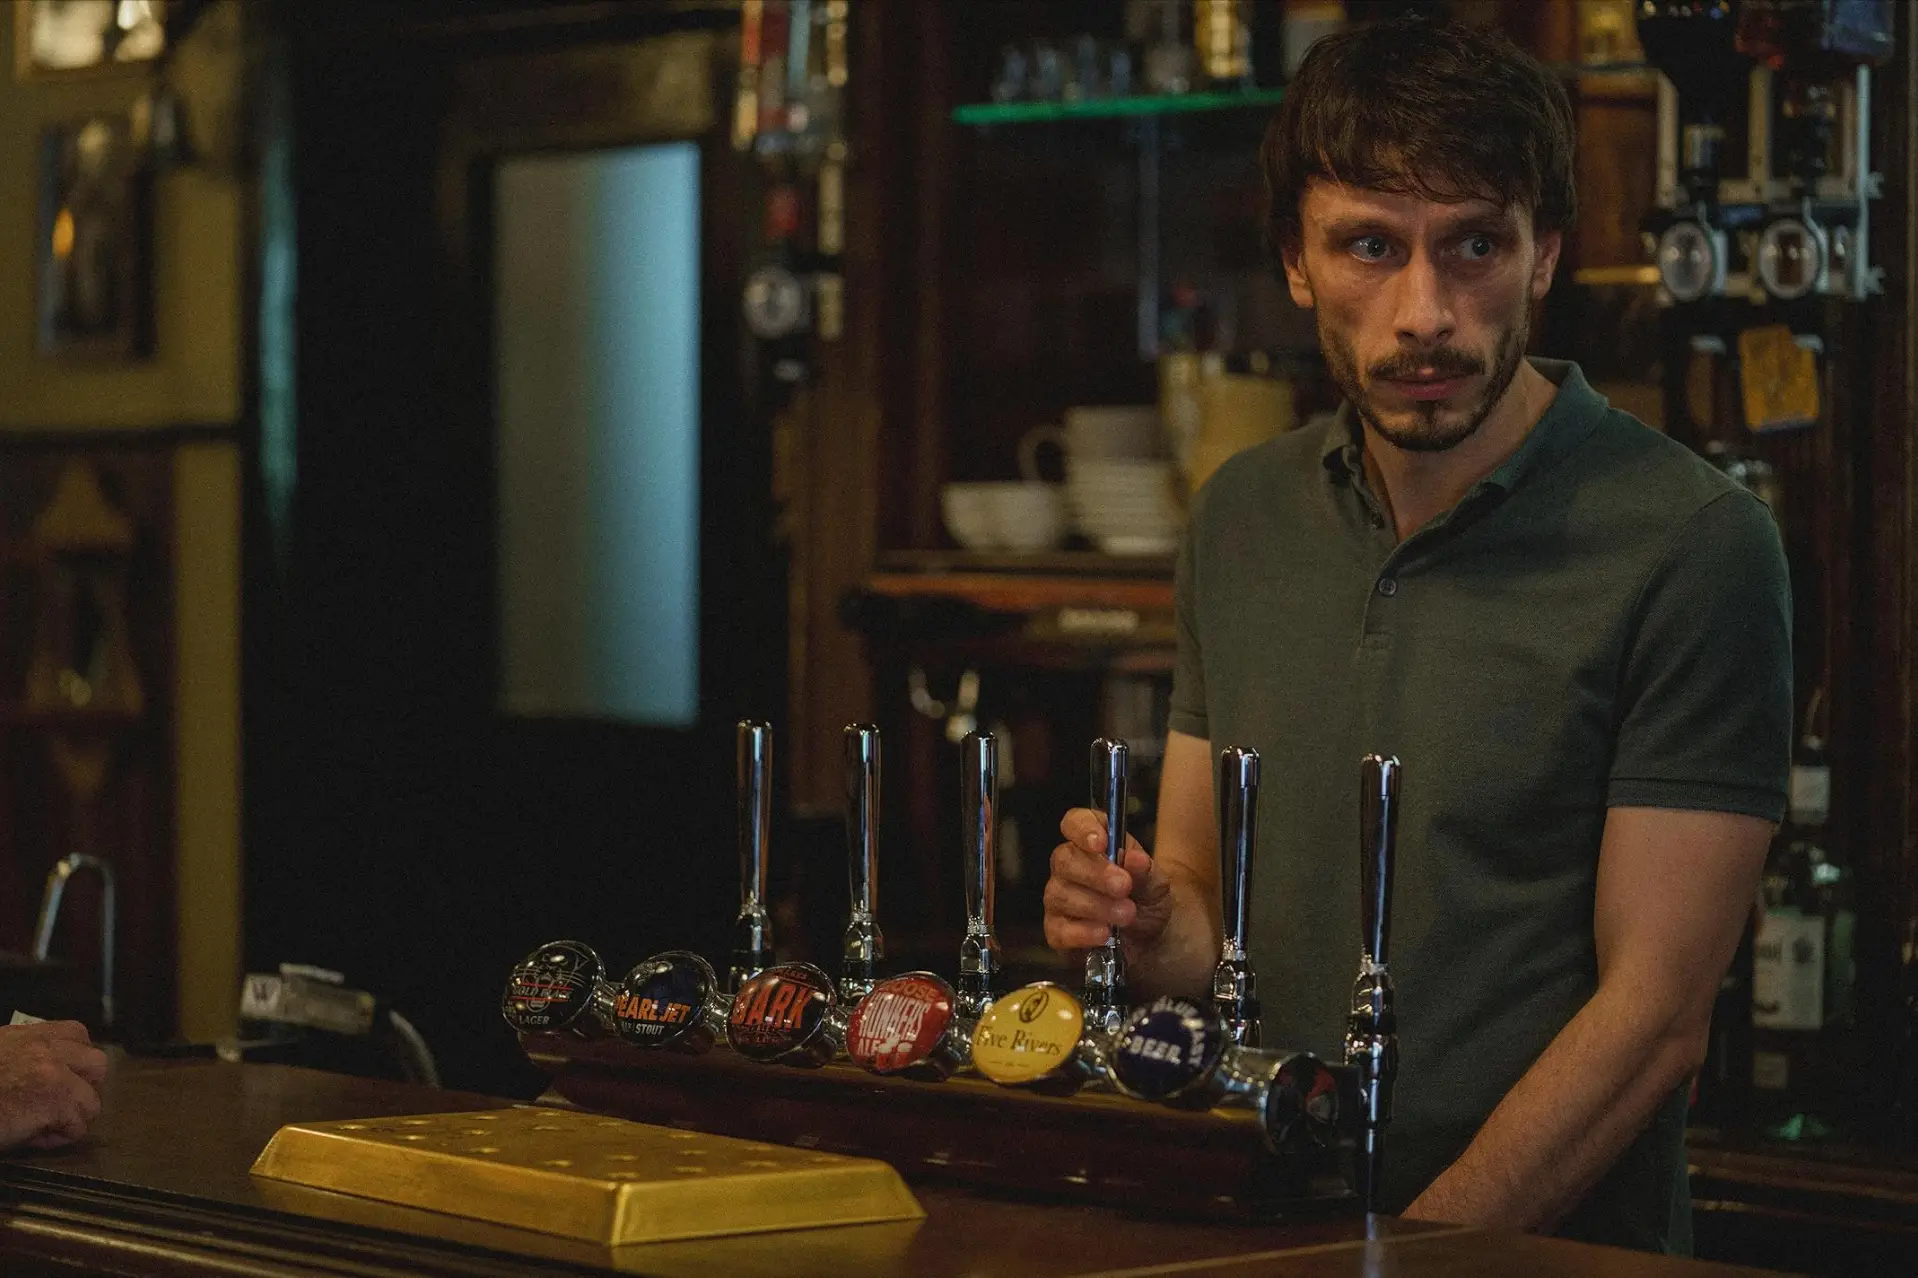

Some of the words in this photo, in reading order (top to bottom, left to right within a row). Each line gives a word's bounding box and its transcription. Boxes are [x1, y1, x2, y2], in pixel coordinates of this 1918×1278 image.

[519, 1015, 550, 1025] LAGER
[660, 1002, 691, 1023] JET
[635, 1023, 665, 1036] STOUT
[1010, 1029, 1060, 1056] Rivers
[1129, 1035, 1182, 1064] BEER
